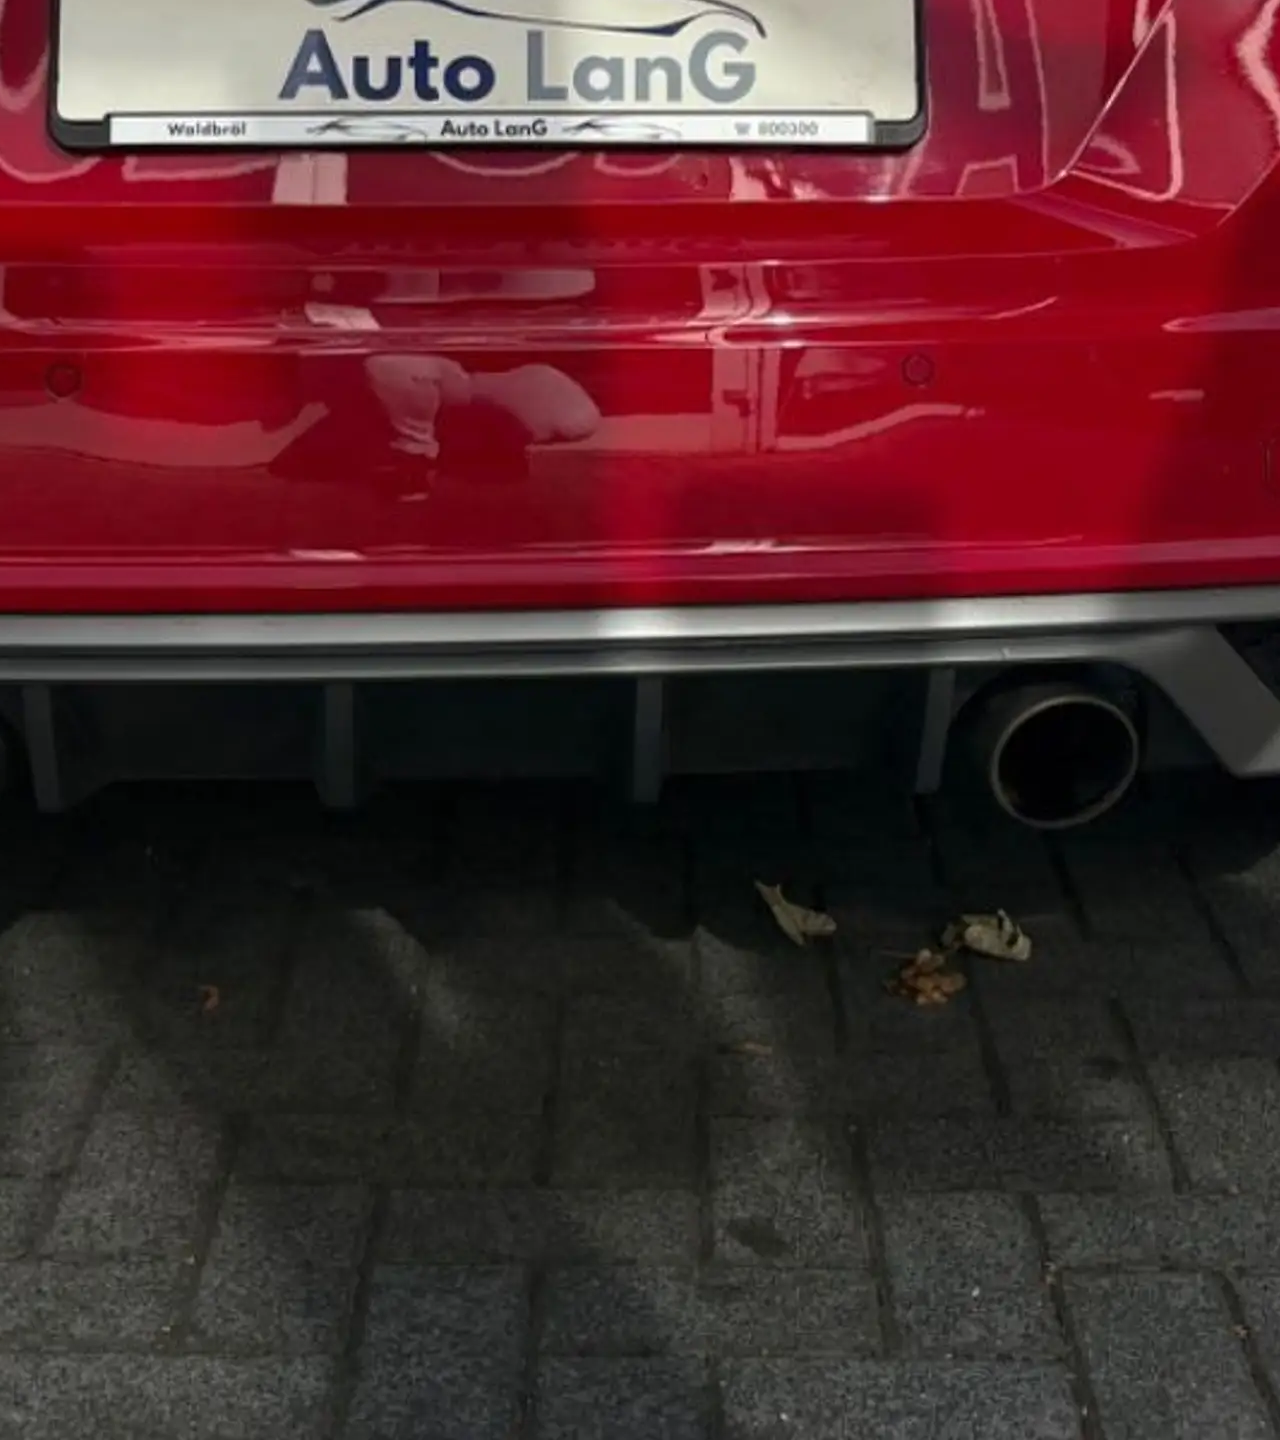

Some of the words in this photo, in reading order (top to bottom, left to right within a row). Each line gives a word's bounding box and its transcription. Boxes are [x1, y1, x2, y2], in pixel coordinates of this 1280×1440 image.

[278, 29, 496, 101] Auto
[526, 29, 757, 103] LanG
[440, 119, 488, 137] Auto
[493, 118, 548, 137] LanG
